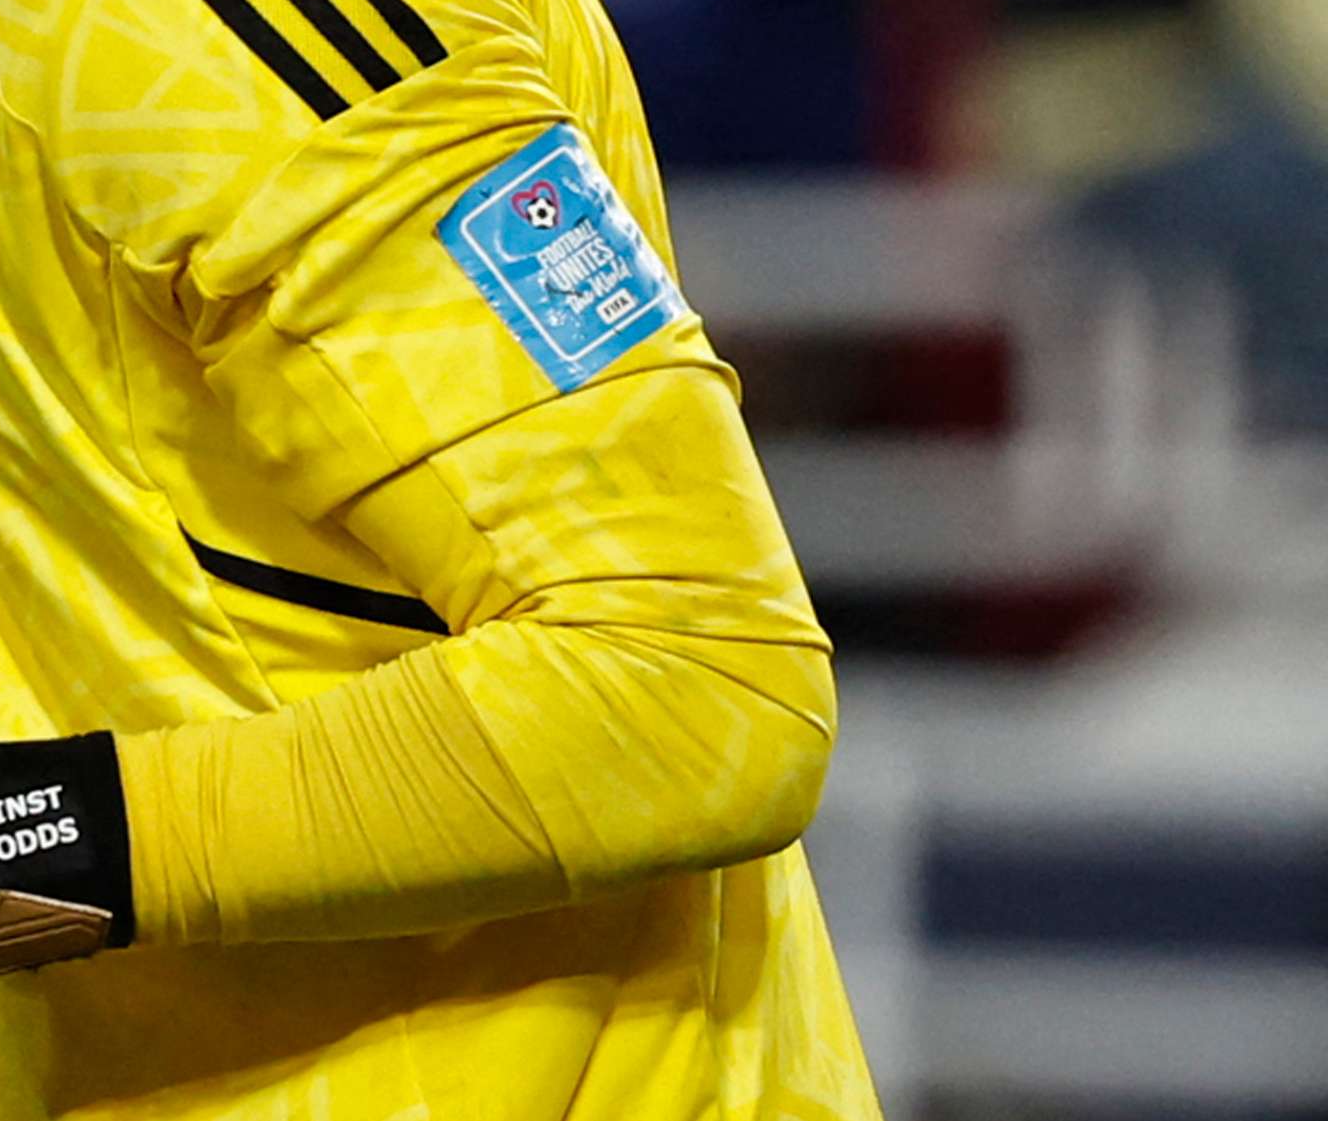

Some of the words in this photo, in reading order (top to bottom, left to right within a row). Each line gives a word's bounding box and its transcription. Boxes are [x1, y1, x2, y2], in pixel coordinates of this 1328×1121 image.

[538, 218, 598, 268] FOOTBALL
[548, 238, 614, 291] UNITES
[602, 296, 629, 317] FIFA
